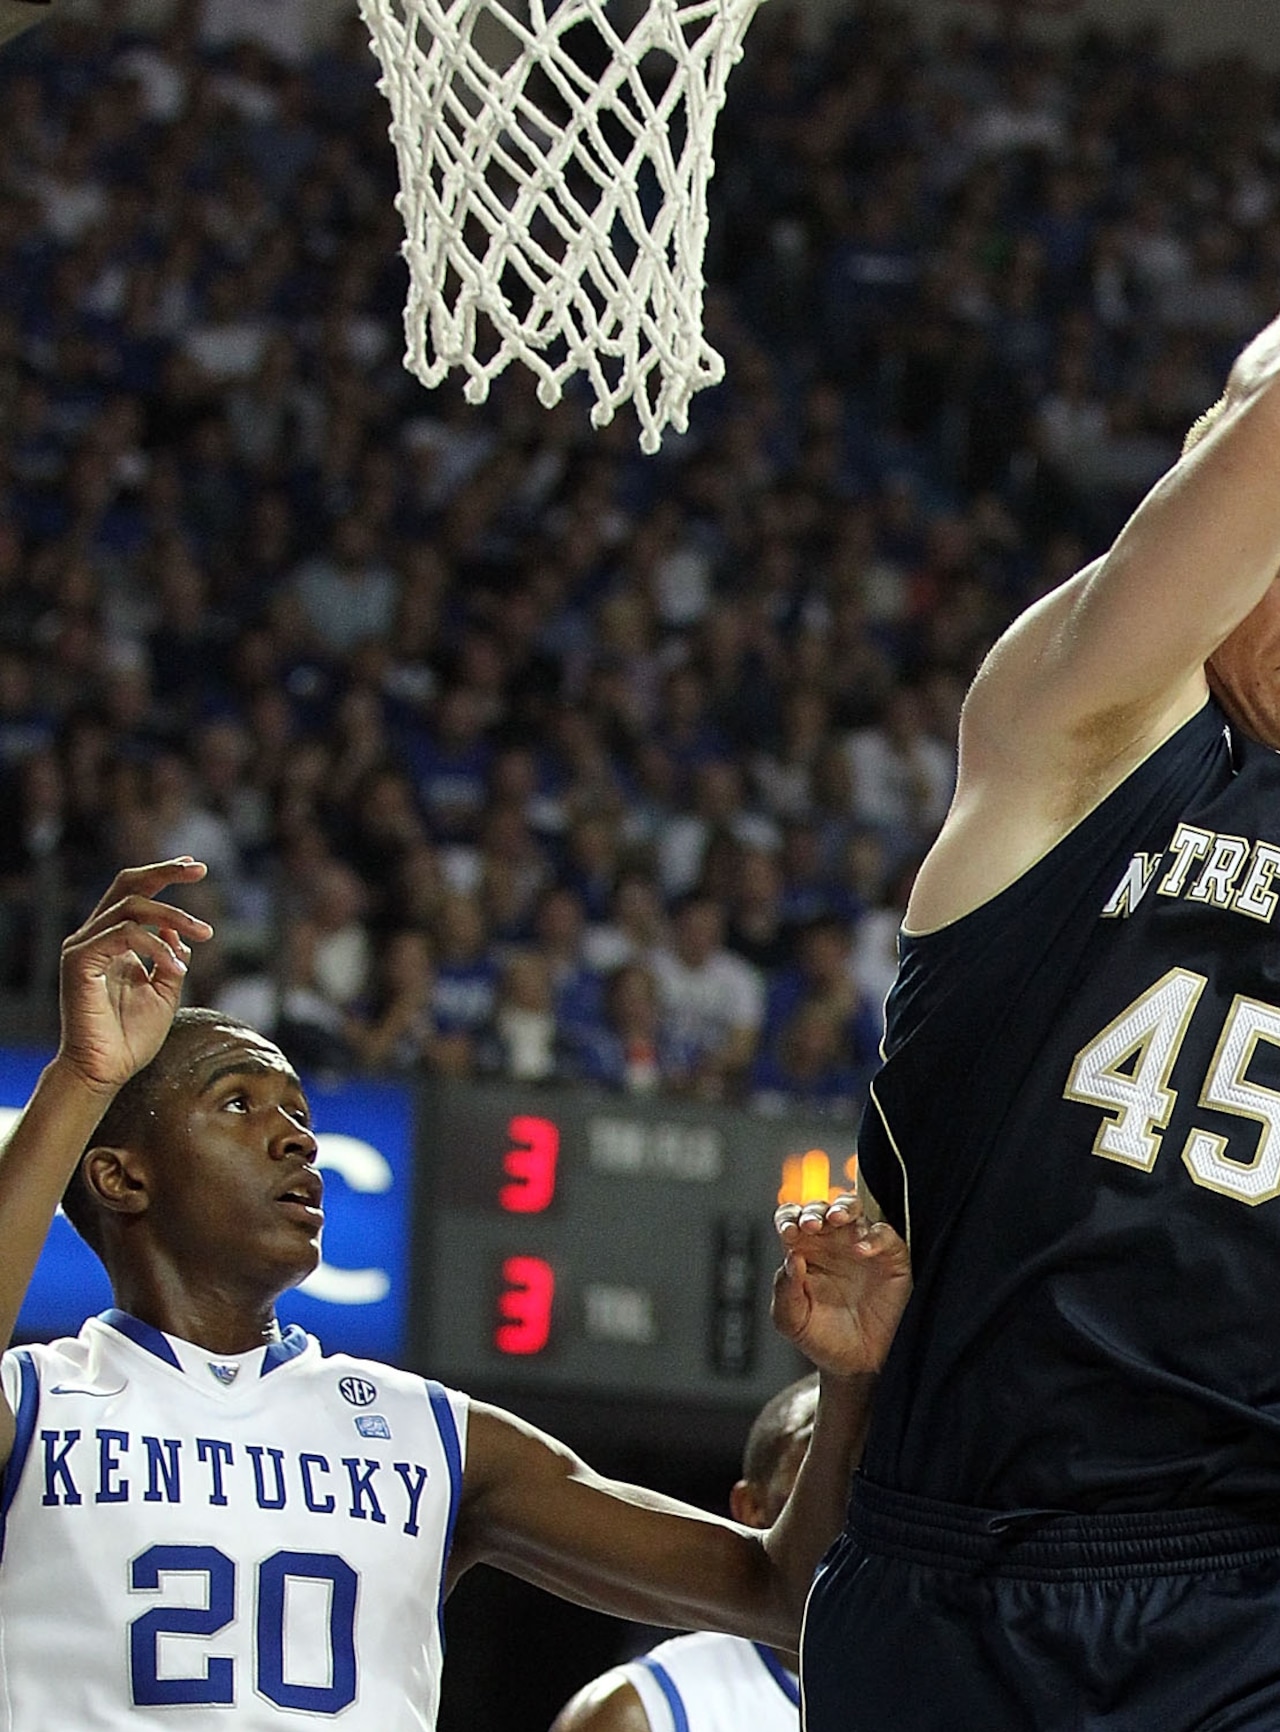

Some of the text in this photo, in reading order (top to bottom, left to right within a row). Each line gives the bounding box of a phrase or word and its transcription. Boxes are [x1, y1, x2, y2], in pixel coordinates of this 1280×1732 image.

[498, 1113, 560, 1214] 3
[494, 1254, 555, 1355] 3
[339, 1377, 376, 1406] SEC
[40, 1428, 430, 1538] KENTUCKY
[126, 1541, 362, 1720] 20
